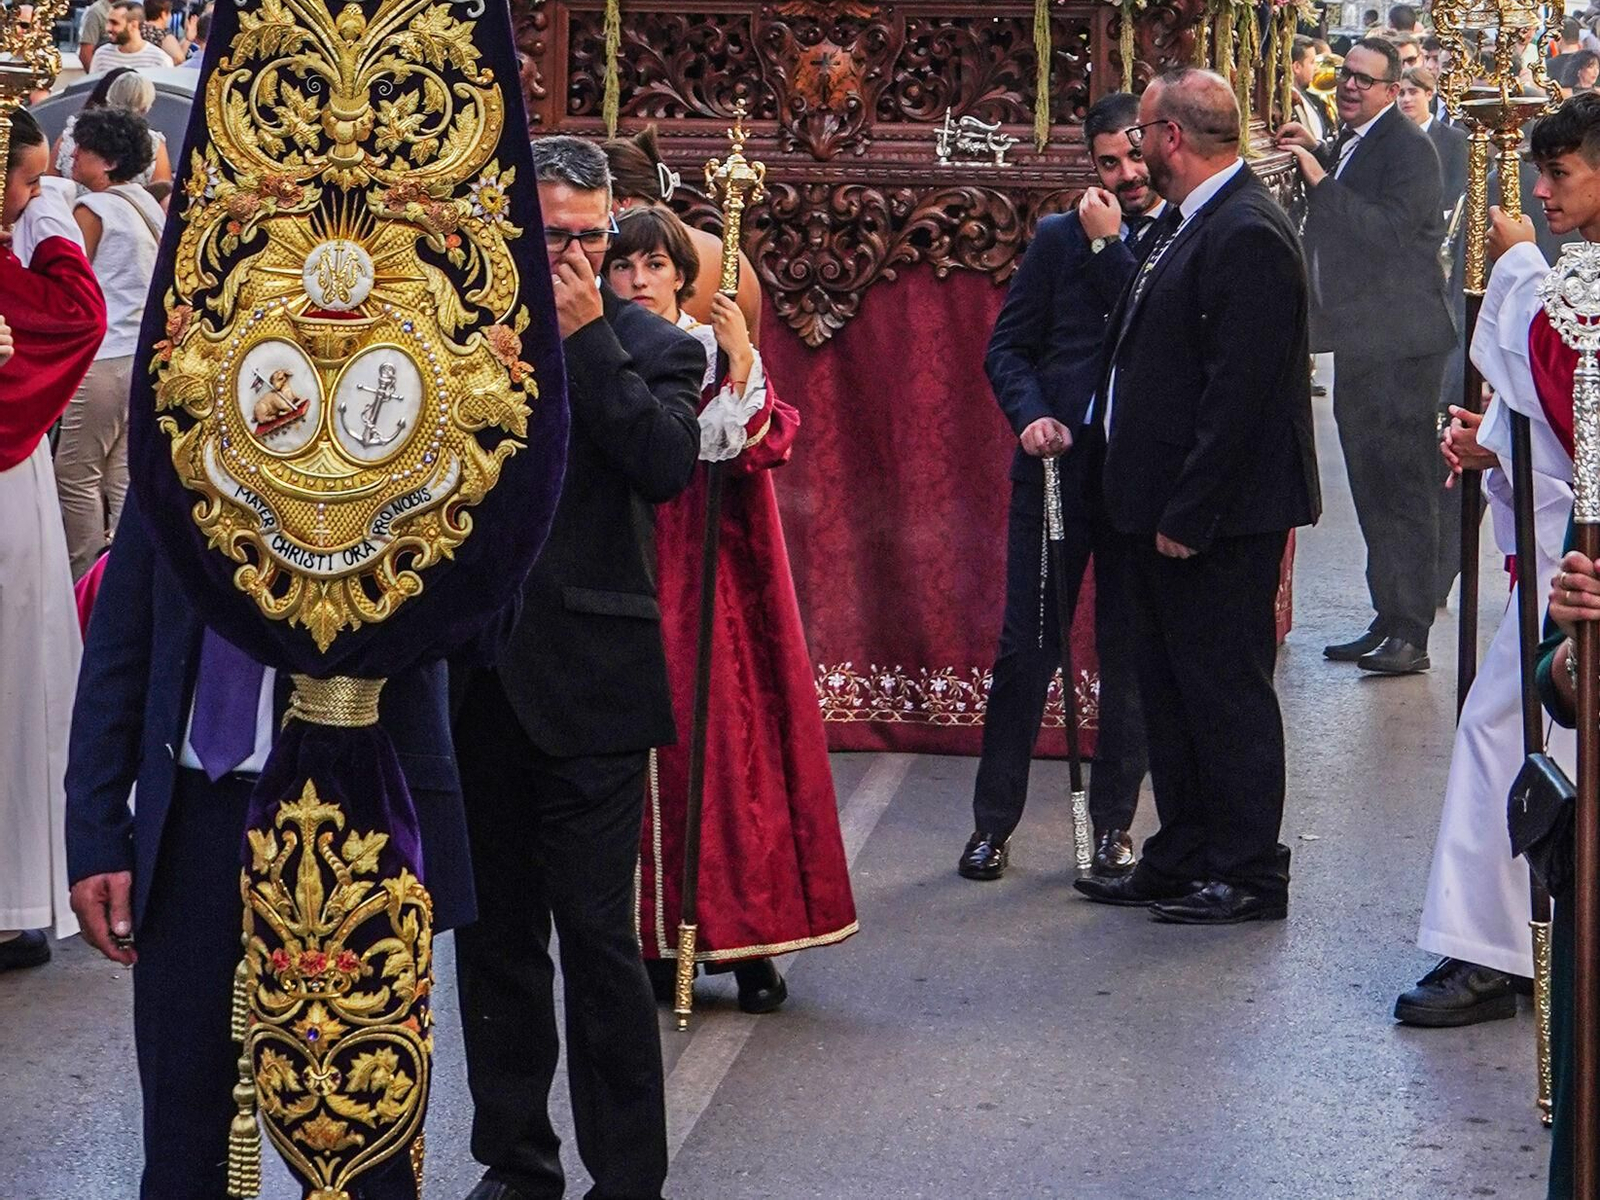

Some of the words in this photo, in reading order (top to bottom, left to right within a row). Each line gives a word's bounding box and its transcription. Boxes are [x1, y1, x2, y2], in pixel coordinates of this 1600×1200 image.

[235, 486, 275, 528] MATER
[272, 535, 332, 571] CHRISTI
[342, 540, 377, 566] ORA
[372, 511, 393, 535] PRO
[391, 487, 432, 515] NOBIS
